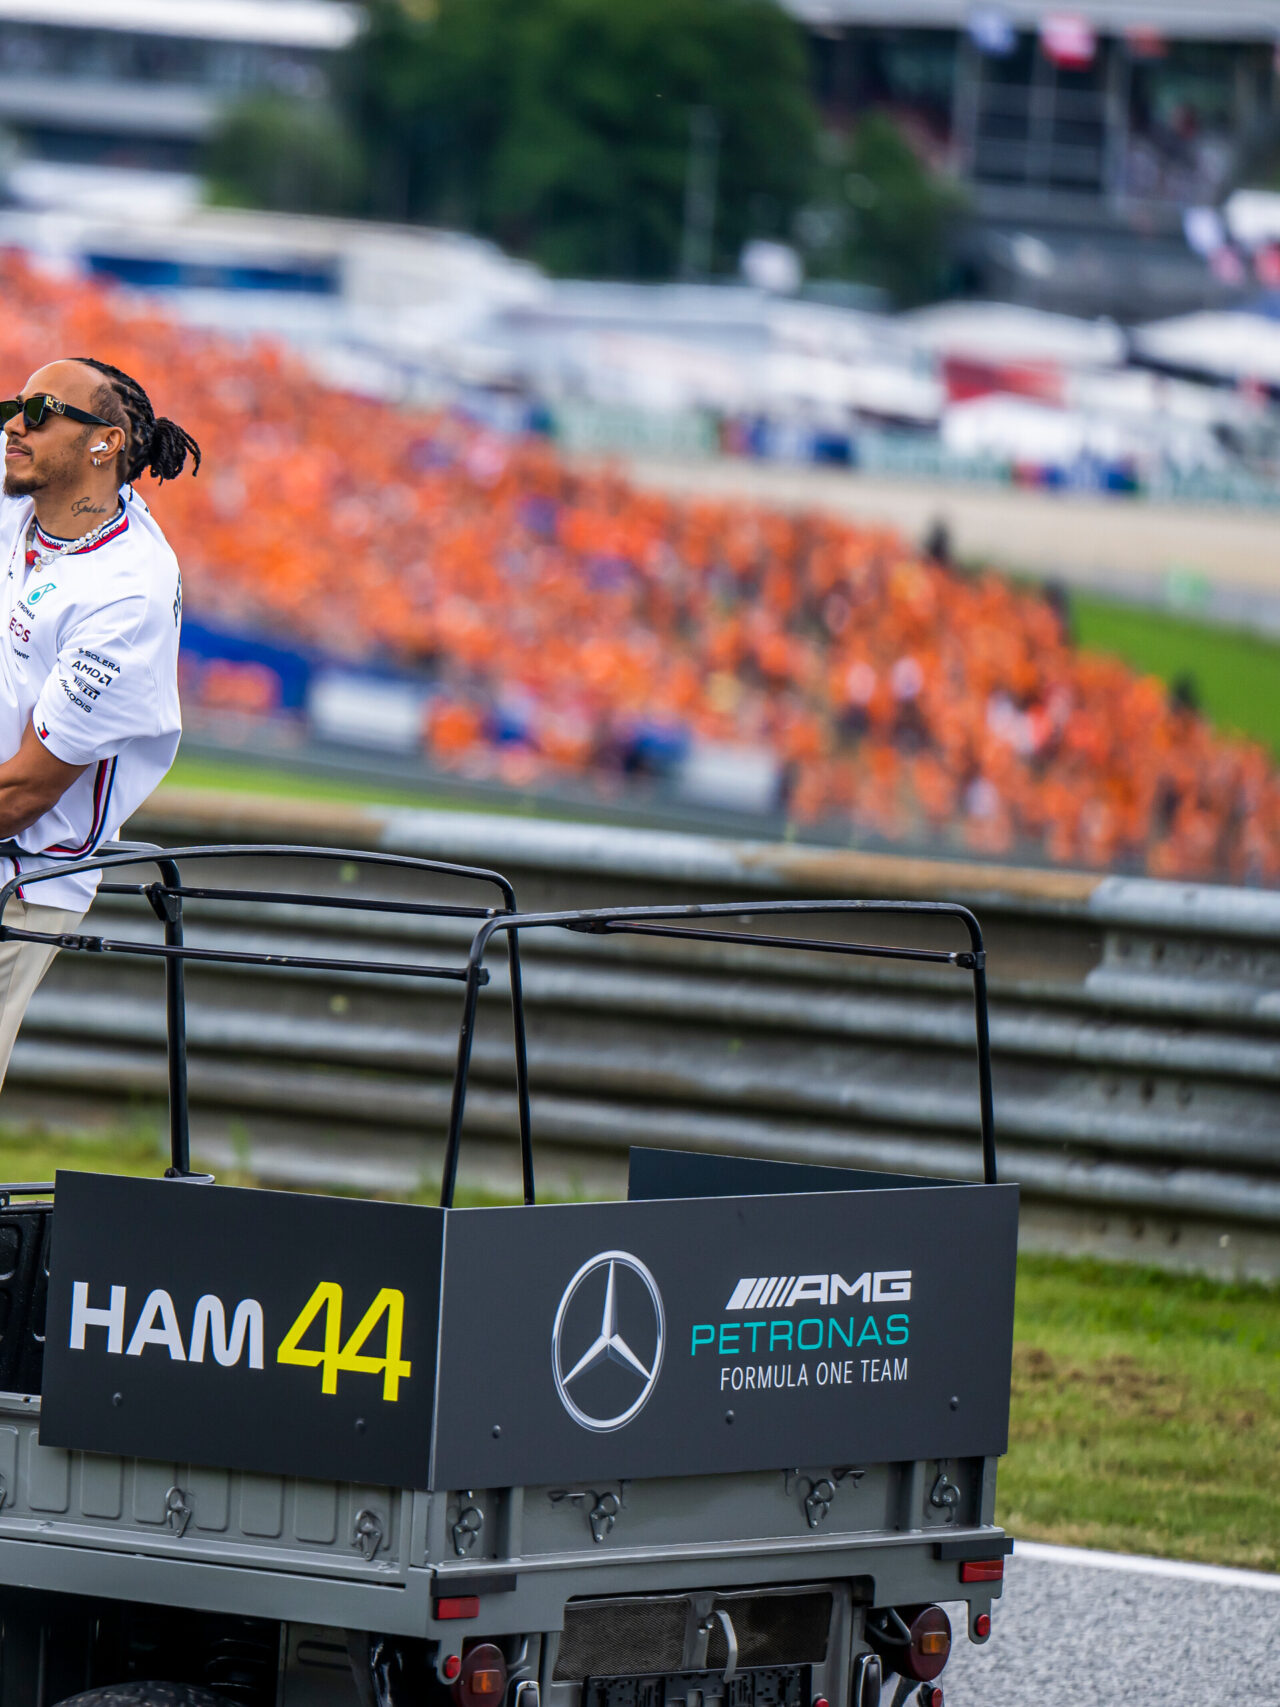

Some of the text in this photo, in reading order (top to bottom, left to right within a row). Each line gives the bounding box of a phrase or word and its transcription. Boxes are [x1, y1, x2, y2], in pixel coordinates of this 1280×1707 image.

[72, 660, 101, 678] AMD
[84, 650, 121, 674] SOLERA
[783, 1270, 912, 1307] AMG
[70, 1281, 412, 1402] HAM 44
[690, 1313, 910, 1356] PETRONAS
[720, 1357, 909, 1391] FORMULA ONE TEAM
